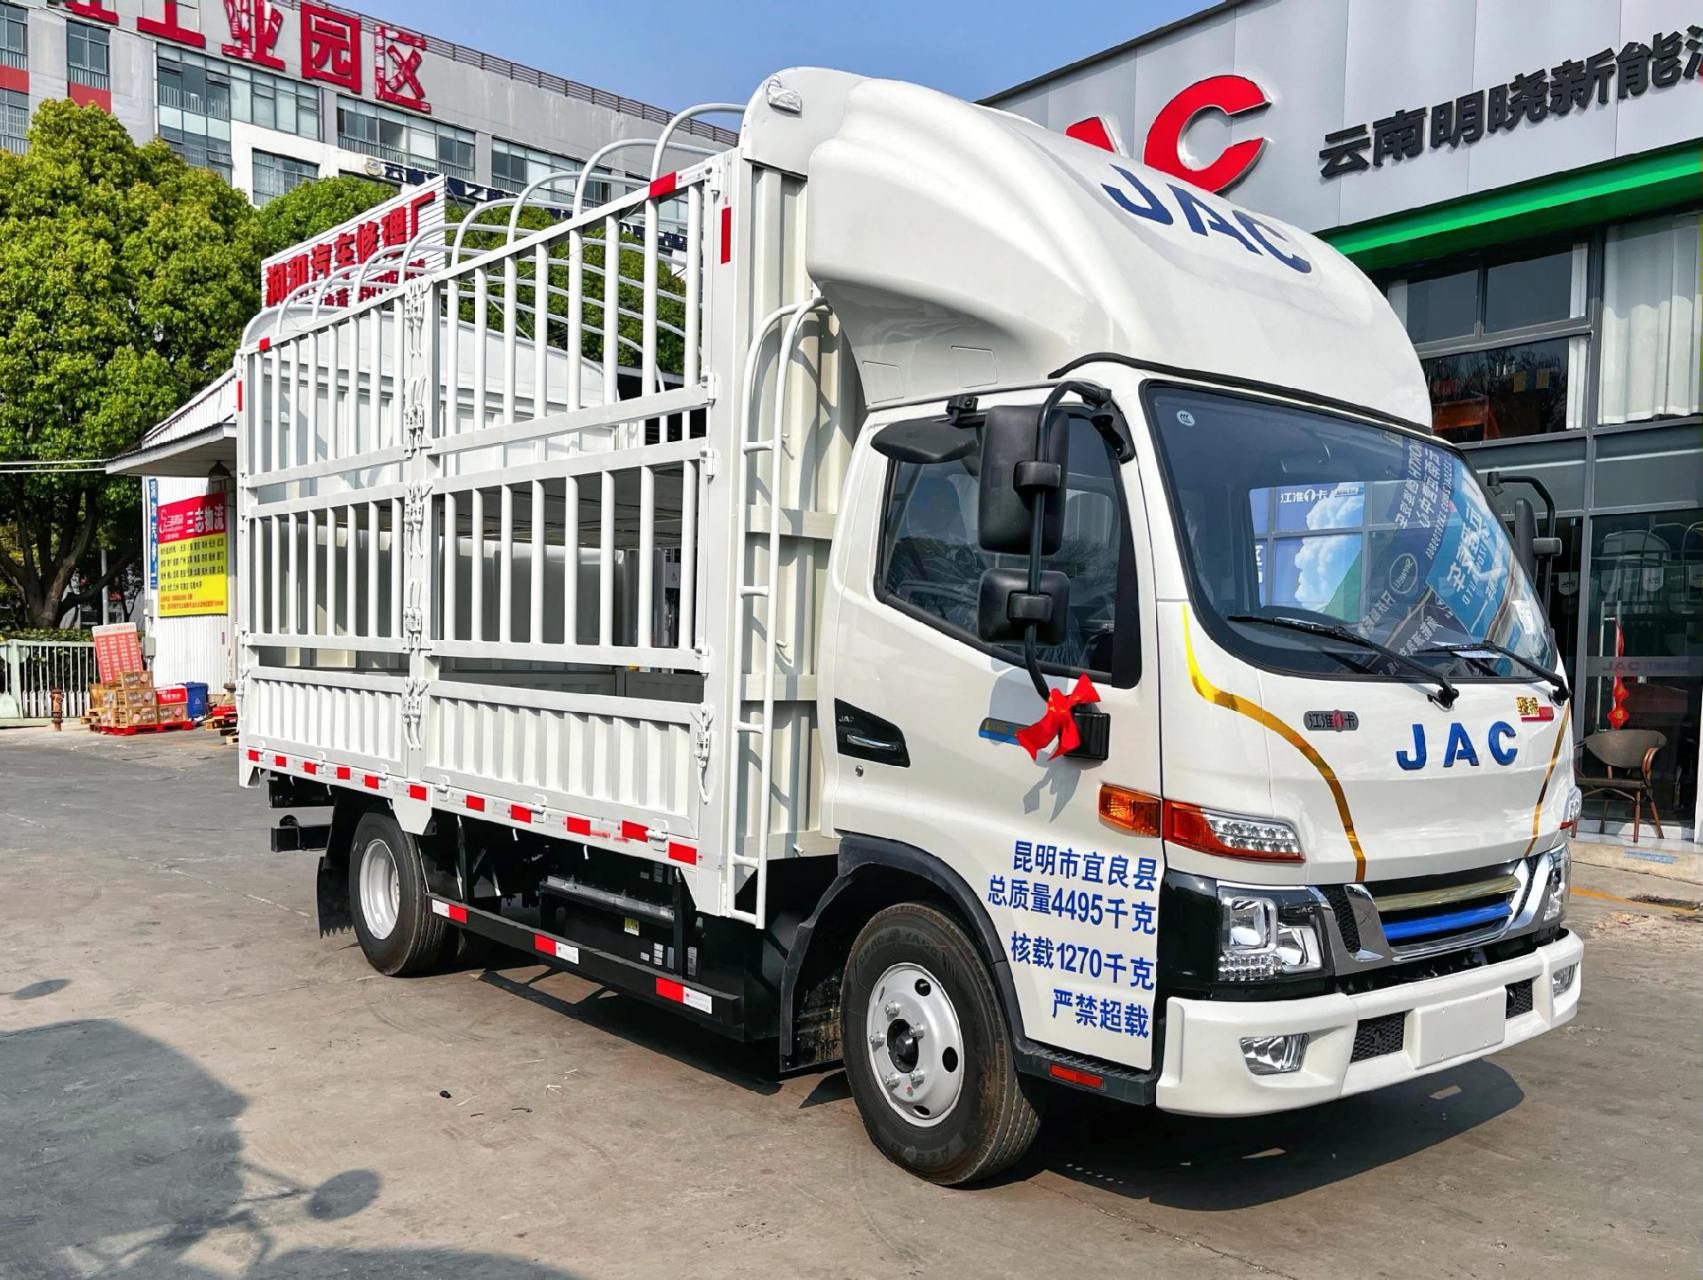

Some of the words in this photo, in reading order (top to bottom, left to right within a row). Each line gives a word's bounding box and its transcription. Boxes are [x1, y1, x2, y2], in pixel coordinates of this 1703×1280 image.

[66, 0, 432, 114] 工业园区
[1101, 163, 1312, 274] JAC
[1396, 720, 1518, 771] JAC
[1012, 840, 1157, 892] 昆明市宜良县
[987, 875, 1157, 935] 总质量4495千克
[1295, 906, 1314, 914] JAC
[1011, 931, 1155, 991] 核载1270千克
[1052, 988, 1149, 1038] 严禁超载
